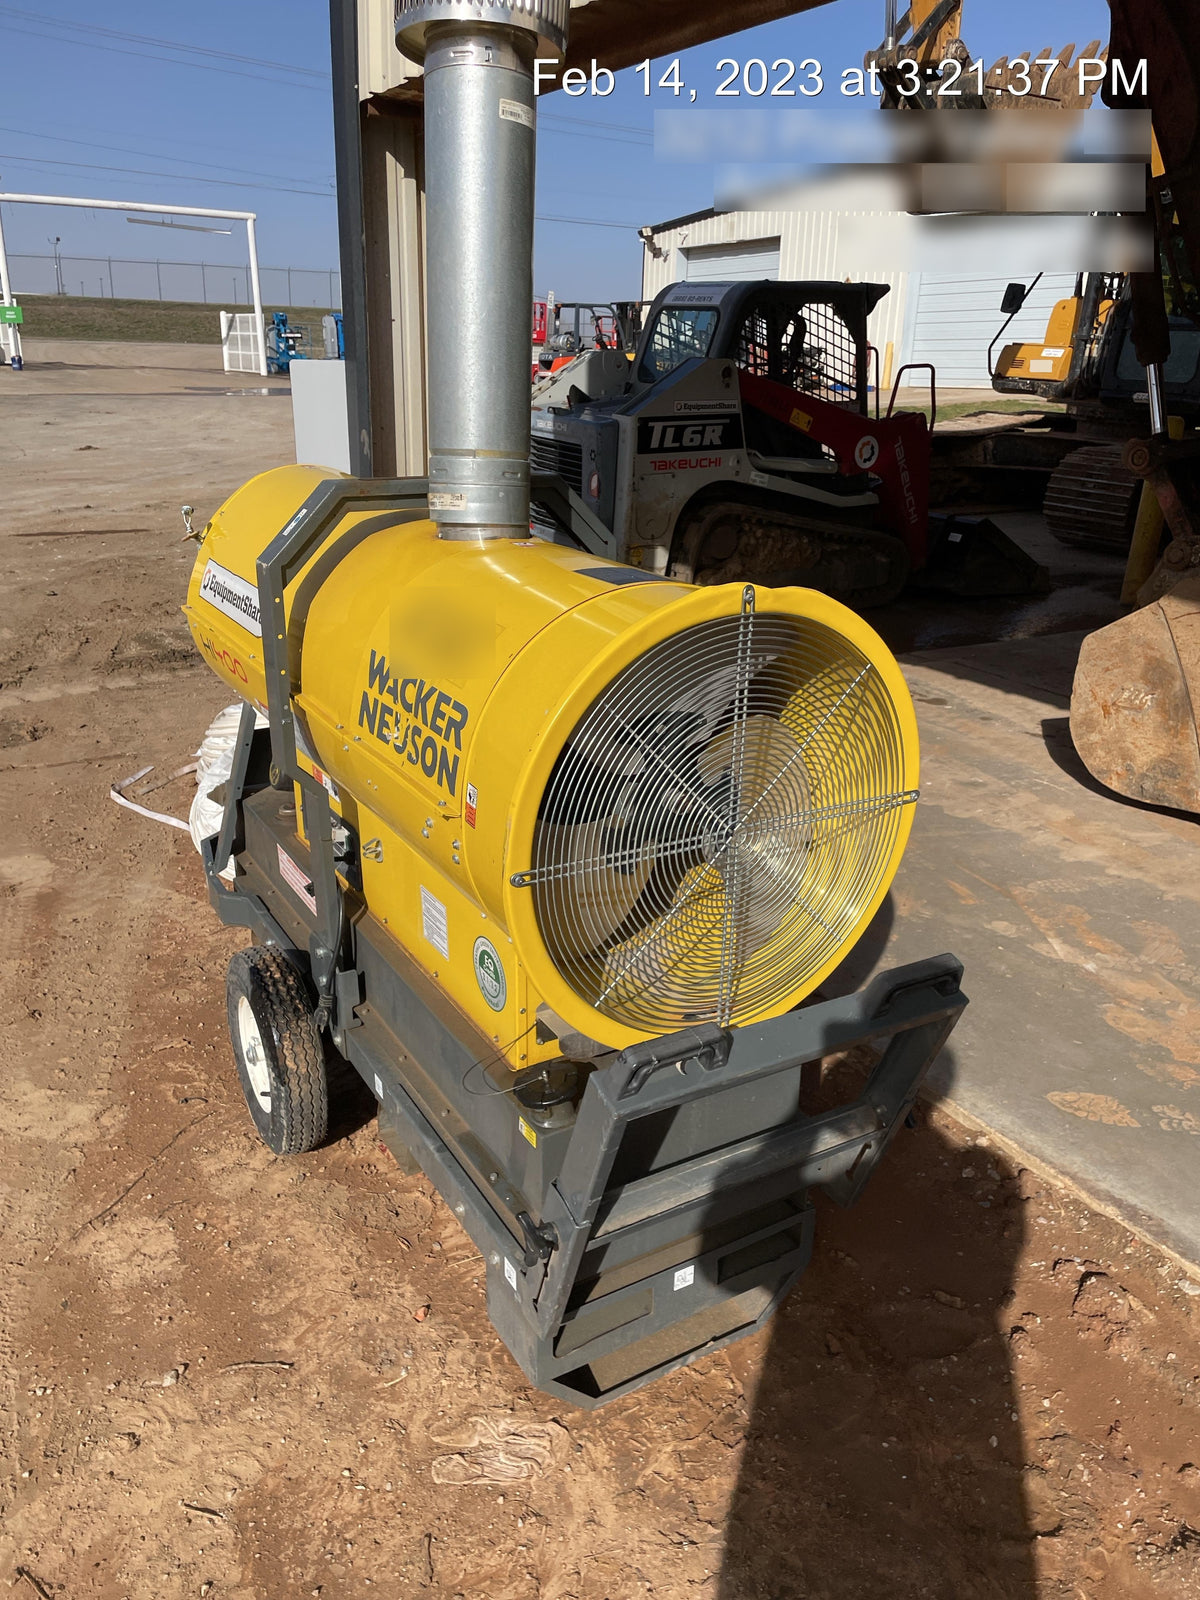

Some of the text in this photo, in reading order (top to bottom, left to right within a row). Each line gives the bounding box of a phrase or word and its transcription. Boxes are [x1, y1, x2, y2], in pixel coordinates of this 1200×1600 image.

[648, 419, 730, 449] TL6R
[650, 457, 722, 471] TAKEUCHI
[209, 570, 262, 625] EquipmentShar
[358, 690, 460, 797] NEUSON
